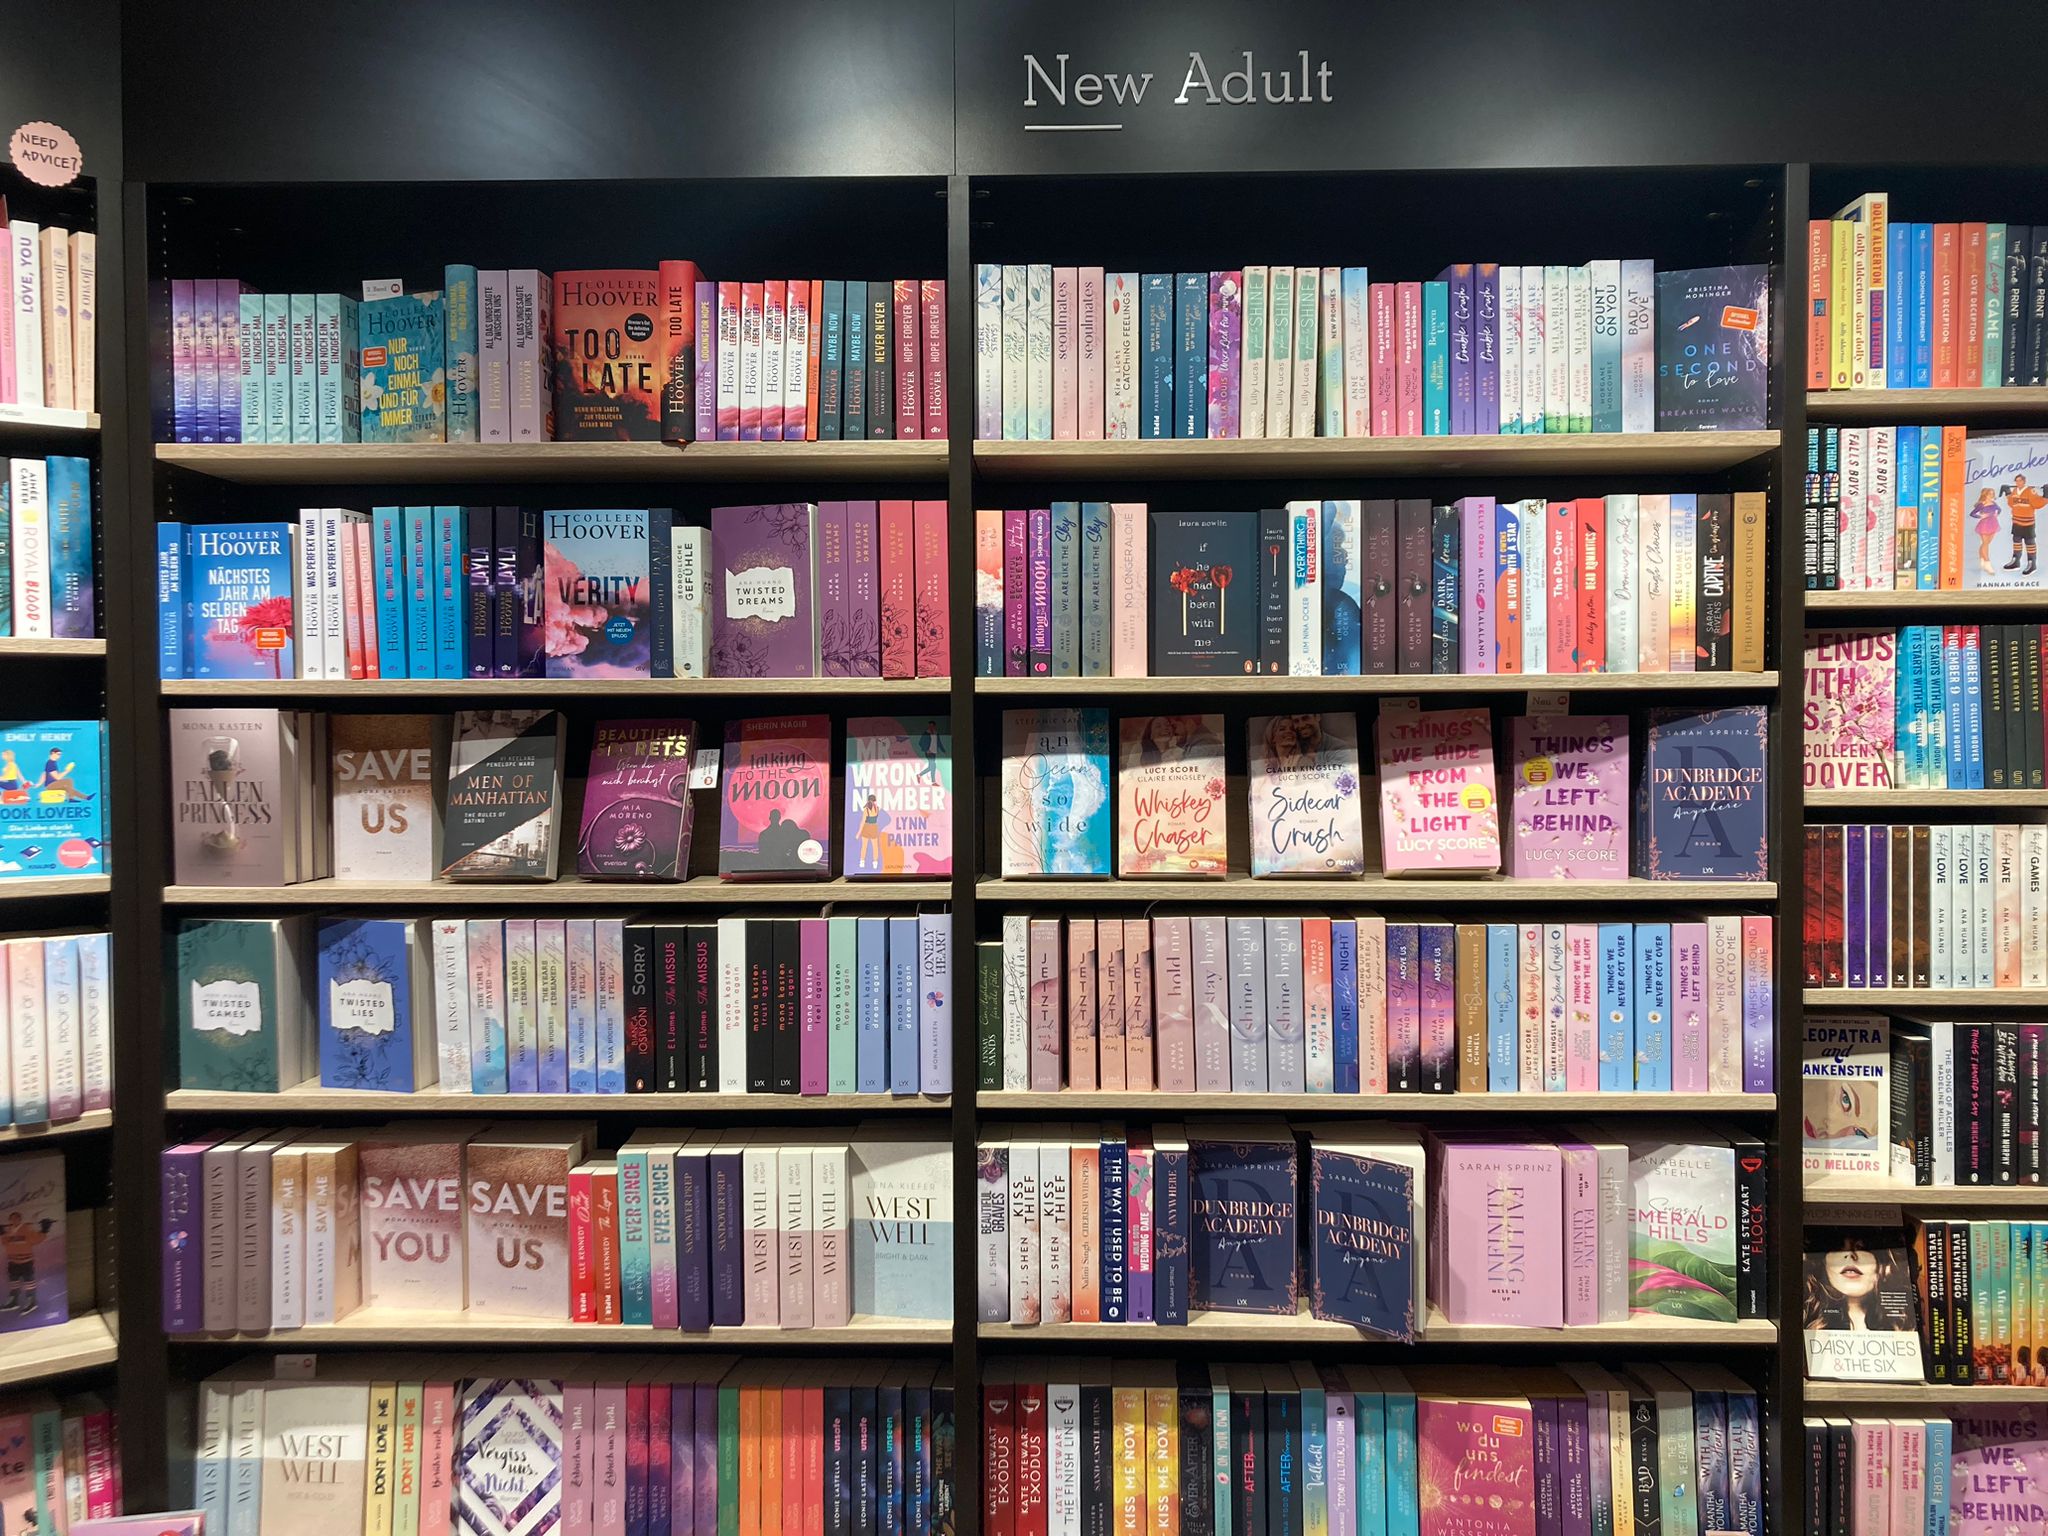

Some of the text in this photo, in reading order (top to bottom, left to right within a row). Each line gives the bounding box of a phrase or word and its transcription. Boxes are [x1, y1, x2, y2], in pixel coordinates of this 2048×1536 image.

[1023, 50, 1333, 106] New Adult
[20, 132, 57, 150] NEED
[21, 150, 78, 175] ADVICE?
[1872, 203, 1882, 285] DOLLY ALDERTON
[20, 237, 34, 313] LOVE, YOU
[586, 280, 656, 290] COLLEEN
[562, 281, 659, 307] HOOVER
[1058, 281, 1067, 360] seoulmates
[1595, 287, 1606, 335] COUNT
[1607, 285, 1617, 336] ON YOU
[1628, 289, 1638, 336] BAD AT
[1639, 296, 1649, 330] LOVE
[1987, 299, 1999, 340] GAME
[368, 312, 437, 336] HOOVER
[874, 302, 885, 363] NEVER NEVER
[388, 339, 408, 355] NUR
[565, 328, 620, 361] TOO
[1122, 292, 1131, 391] CATCHING FEELINGS
[1685, 343, 1731, 358] ONE
[394, 354, 419, 372] NOCH
[1660, 359, 1757, 377] SECOND
[388, 371, 422, 390] EINMAL
[583, 362, 653, 394] LATE
[1683, 372, 1739, 390] to love
[379, 391, 418, 409] UND FÜR
[381, 405, 413, 427] IMMER
[1847, 434, 1860, 495] FALLS BOYS
[549, 515, 646, 540] HOOVER
[573, 514, 644, 523] COLLEEN
[1506, 521, 1517, 540] STAR
[201, 533, 282, 556] HOOVER
[220, 531, 279, 541] COLLEEN
[1507, 542, 1516, 550] A
[1295, 522, 1306, 579] EVERYTHING
[1507, 551, 1517, 574] WITH
[209, 566, 270, 585] NÄCHSTES
[471, 547, 489, 586] LAYLA
[684, 543, 694, 601] GEFÜHLE
[1704, 555, 1724, 596] CAPTIVE
[219, 586, 271, 601] JAHR AM
[558, 576, 640, 606] VERITY
[736, 585, 786, 596] TWISTED
[1507, 577, 1517, 599] LOVE
[202, 601, 247, 618] SELBEN
[738, 596, 784, 606] DREAMS
[216, 618, 238, 634] TAG
[1817, 633, 1893, 662] ENDS
[1948, 633, 1959, 683] NOVEMBER
[5, 733, 73, 742] EMILY HENRY
[1530, 736, 1614, 754] THINGS
[856, 738, 890, 762] MR
[336, 749, 431, 781] SAVE
[737, 769, 787, 781] TO THE
[750, 752, 815, 774] talking
[1145, 765, 1199, 774] LUCY SCORE
[1556, 762, 1589, 779] WE
[466, 775, 534, 789] MEN OF
[1408, 769, 1466, 784] FROM
[1654, 768, 1763, 784] DUNBRIDGE
[184, 780, 264, 803] FALLEN
[451, 790, 547, 806] MANHATTAN
[1418, 792, 1458, 808] THE
[1545, 788, 1600, 805] LEFT
[1662, 786, 1754, 801] ACADEMY
[37, 807, 91, 819] LOVERS
[179, 802, 272, 826] PRINCESS
[1134, 787, 1212, 822] Whiskey
[1267, 787, 1345, 822] Sidecar
[361, 803, 408, 834] US
[895, 816, 927, 831] LYNN
[1410, 816, 1471, 833] LIGHT
[1532, 814, 1613, 832] BEHIND
[888, 833, 939, 847] PAINTER
[1134, 819, 1212, 855] Chaser
[1271, 819, 1345, 855] Crush
[1396, 837, 1487, 852] LUCY SCORE
[1937, 858, 1946, 884] LOVE
[2001, 858, 2010, 883] HATE
[2031, 857, 2040, 892] GAMES
[665, 942, 676, 984] MISSUS
[924, 928, 934, 977] LONELY
[936, 930, 947, 975] HEART
[633, 943, 646, 995] SORRY
[1167, 957, 1181, 997] hold
[1617, 935, 1626, 1007] NEVER GOT OVER
[203, 999, 251, 1009] TWISTED
[208, 1009, 246, 1018] GAMES
[340, 998, 385, 1008] TWISTED
[351, 1009, 374, 1018] LIES
[1110, 1158, 1122, 1184] THE
[1825, 1159, 1879, 1171] MELLORS
[364, 1176, 459, 1211] SAVE
[623, 1162, 641, 1243] EVER SINCE
[1012, 1181, 1024, 1218] KISS
[1024, 1175, 1035, 1224] THIEF
[1110, 1188, 1122, 1214] WAY
[866, 1195, 937, 1220] WEST
[1194, 1200, 1292, 1218] DUNBRIDGE
[869, 1222, 934, 1245] WELL
[1201, 1217, 1286, 1236] ACADEMY
[1649, 1227, 1709, 1243] HILLS
[1741, 1184, 1751, 1273] KATE STEWART
[1752, 1204, 1763, 1255] FLOCK
[372, 1230, 450, 1263] YOU
[496, 1237, 545, 1270] US
[1112, 1227, 1122, 1257] USED
[1112, 1263, 1122, 1282] TO
[1929, 1233, 1938, 1298] EVELYN HUGO
[1112, 1285, 1122, 1303] BE
[1810, 1339, 1916, 1357] DAISY JONES
[376, 1398, 389, 1453] LOVE ME
[280, 1435, 349, 1458] WEST
[282, 1460, 345, 1484] WELL
[998, 1436, 1009, 1504] EXODUS
[1124, 1422, 1136, 1528] KISS ME NOW
[1973, 1475, 2028, 1493] LEFT
[1963, 1502, 2043, 1521] BEHIND
